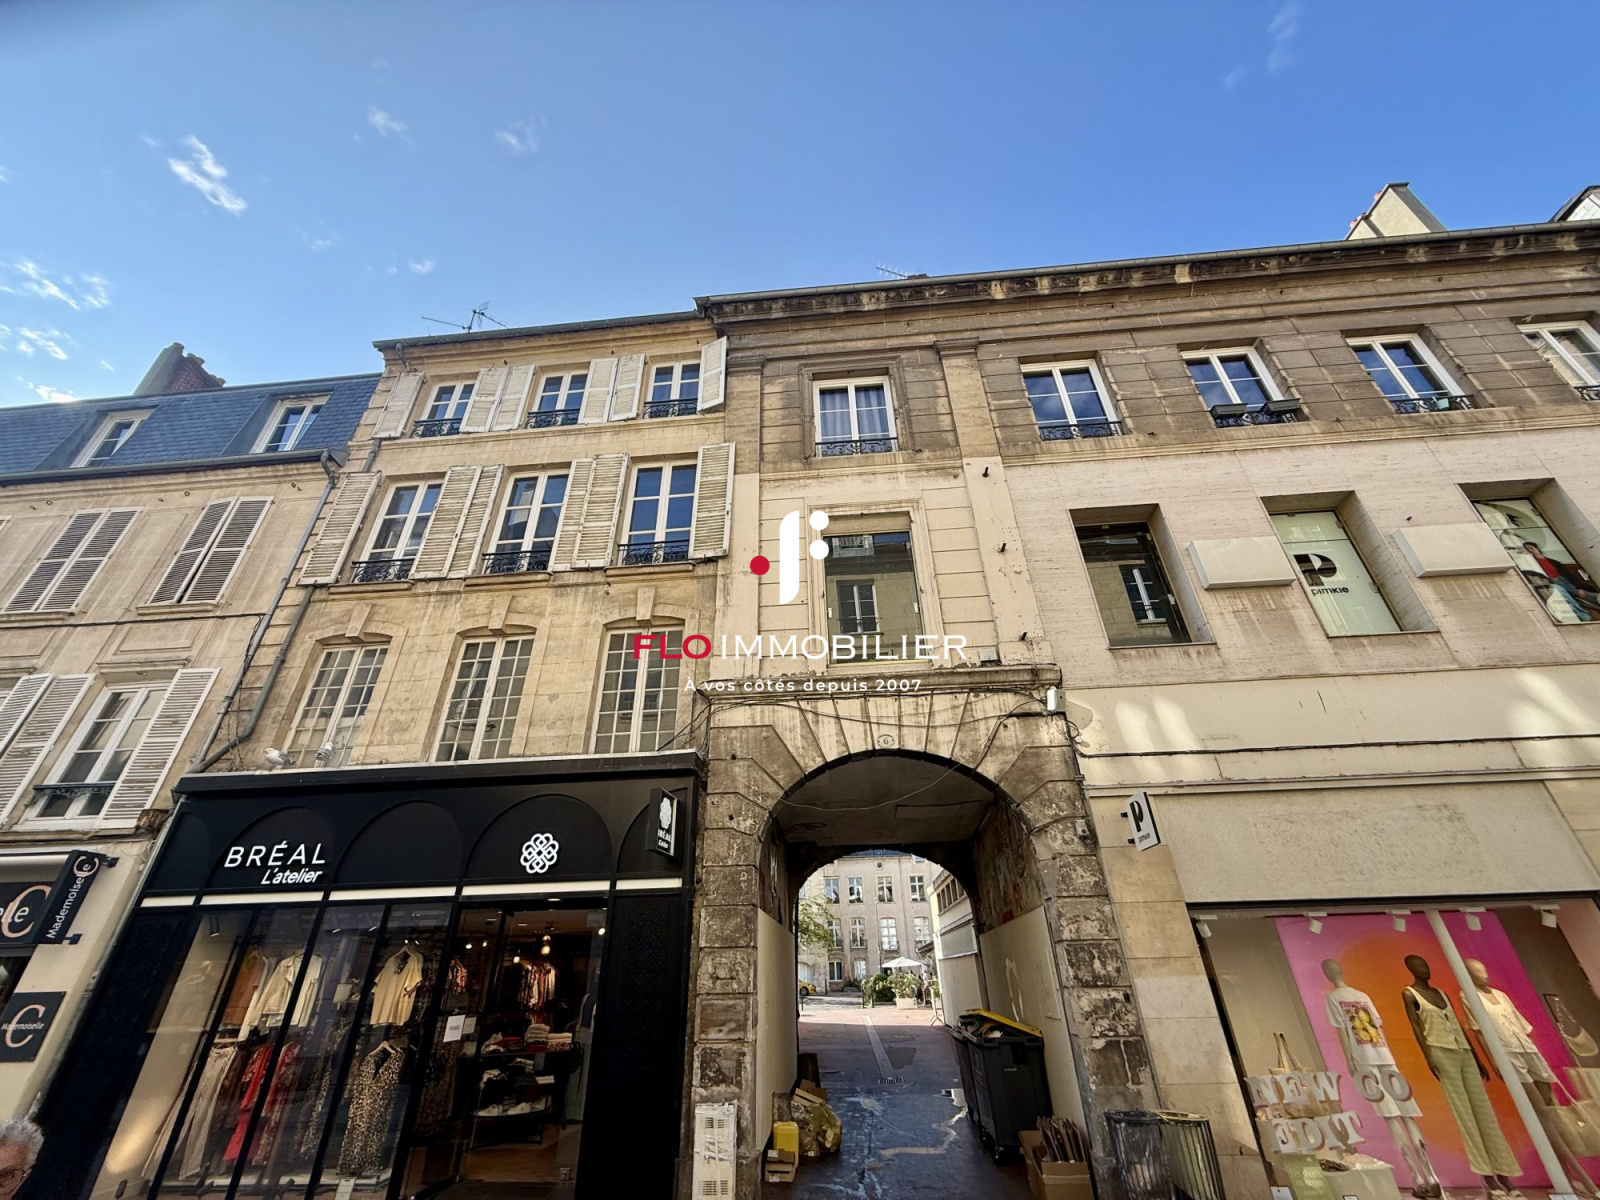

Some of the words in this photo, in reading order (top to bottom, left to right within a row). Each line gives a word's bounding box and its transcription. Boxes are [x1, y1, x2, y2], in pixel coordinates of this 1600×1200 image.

[1311, 587, 1350, 597] pimkie
[223, 840, 326, 868] BRÉAL
[260, 867, 324, 885] L'atelier
[0, 1021, 45, 1030] Maemoiselle
[1243, 1071, 1342, 1106] NEW
[1352, 1069, 1413, 1102] CO
